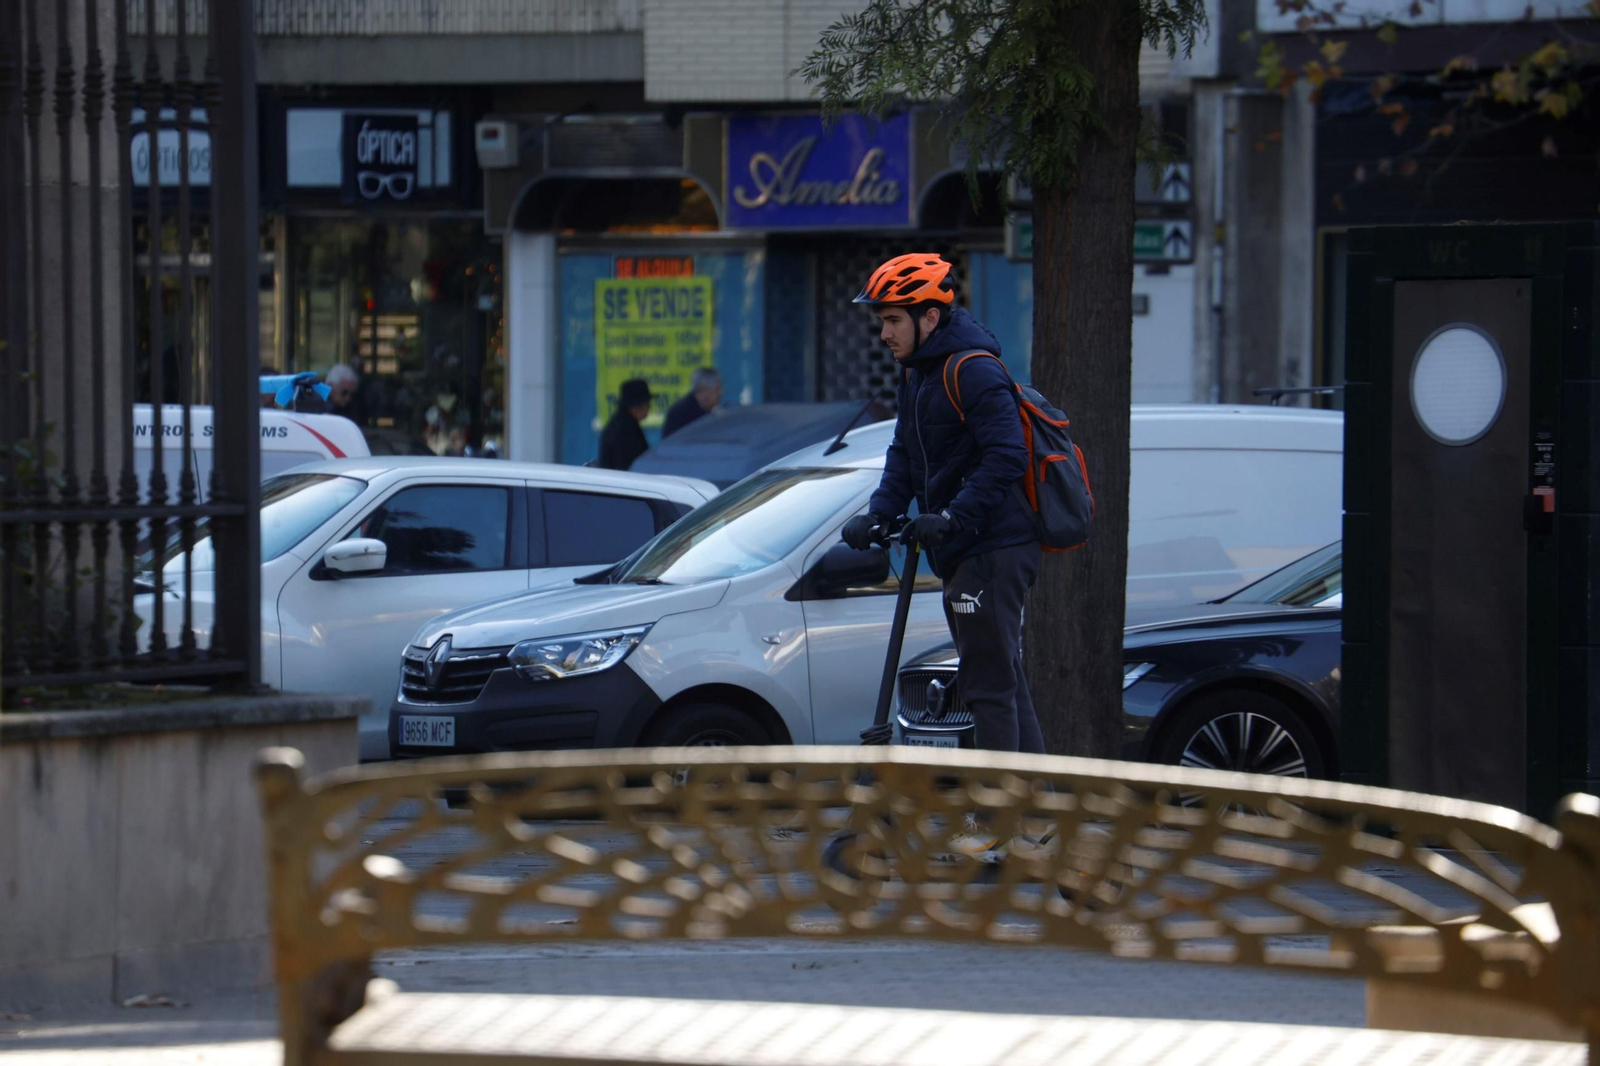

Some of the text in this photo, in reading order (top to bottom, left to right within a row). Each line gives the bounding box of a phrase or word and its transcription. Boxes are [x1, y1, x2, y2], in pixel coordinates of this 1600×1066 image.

[137, 140, 211, 173] ÓTIOS
[357, 119, 415, 165] ÓPTICA
[733, 135, 900, 209] Amelia
[1427, 240, 1470, 264] WC
[603, 286, 705, 320] SE VENDE
[405, 721, 452, 743] 9656 MCF
